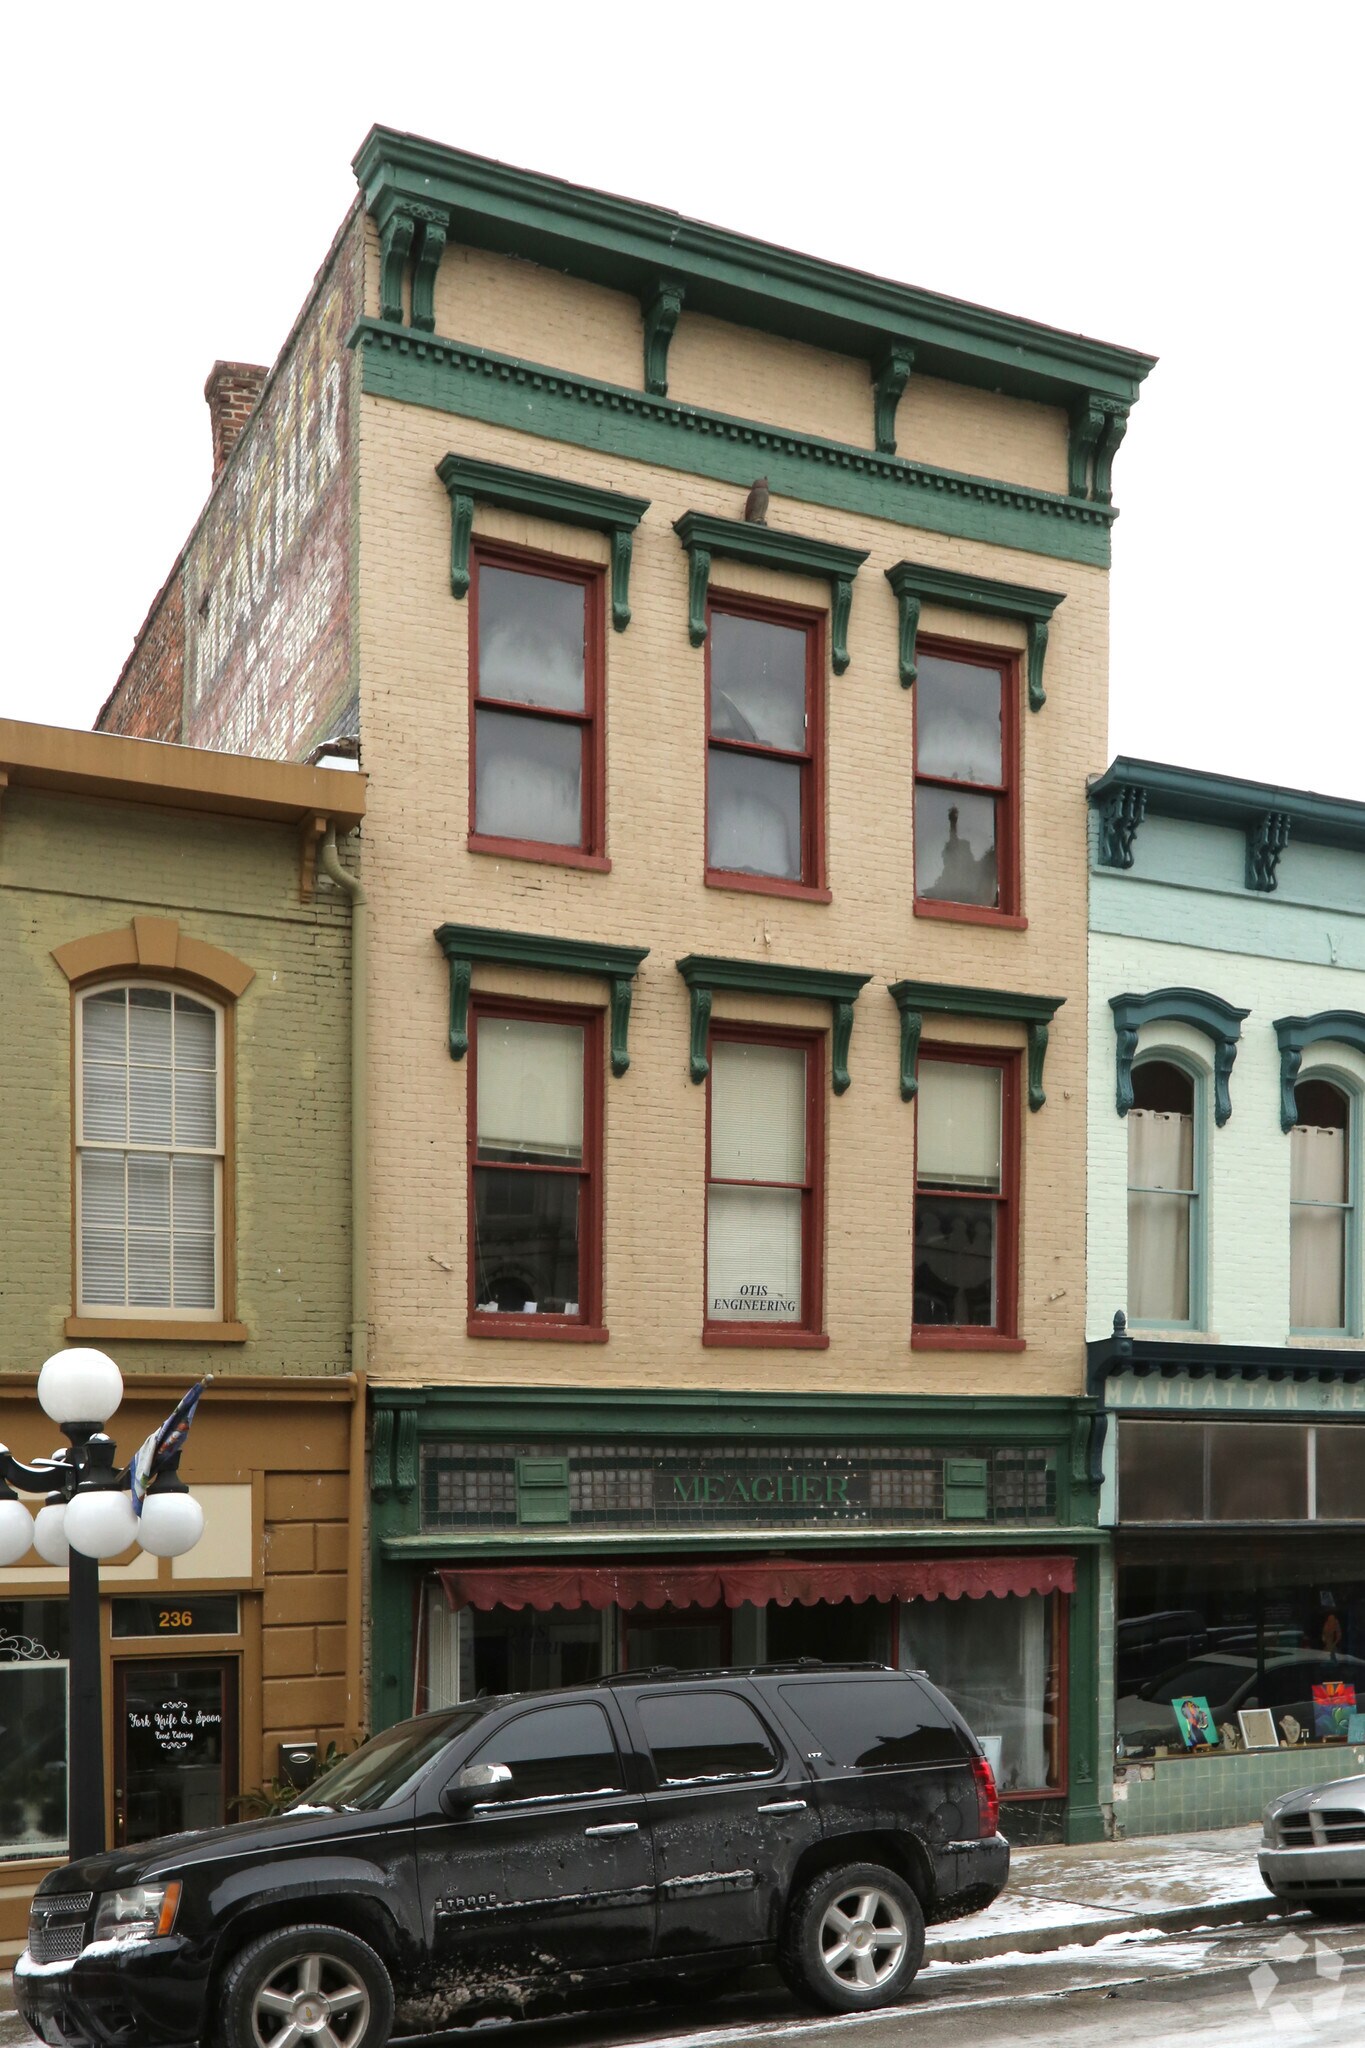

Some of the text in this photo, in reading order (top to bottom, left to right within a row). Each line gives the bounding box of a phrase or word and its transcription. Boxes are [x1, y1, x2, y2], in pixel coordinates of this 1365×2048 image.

[740, 1285, 768, 1296] OTIS
[713, 1298, 796, 1312] ENGINEERING
[1104, 1380, 1299, 1408] MANHATTAN
[673, 1475, 849, 1503] MEAGHER
[159, 1611, 193, 1627] 236
[129, 1710, 222, 1730] Fork Knife & Spoon
[155, 1731, 193, 1741] Event Catering
